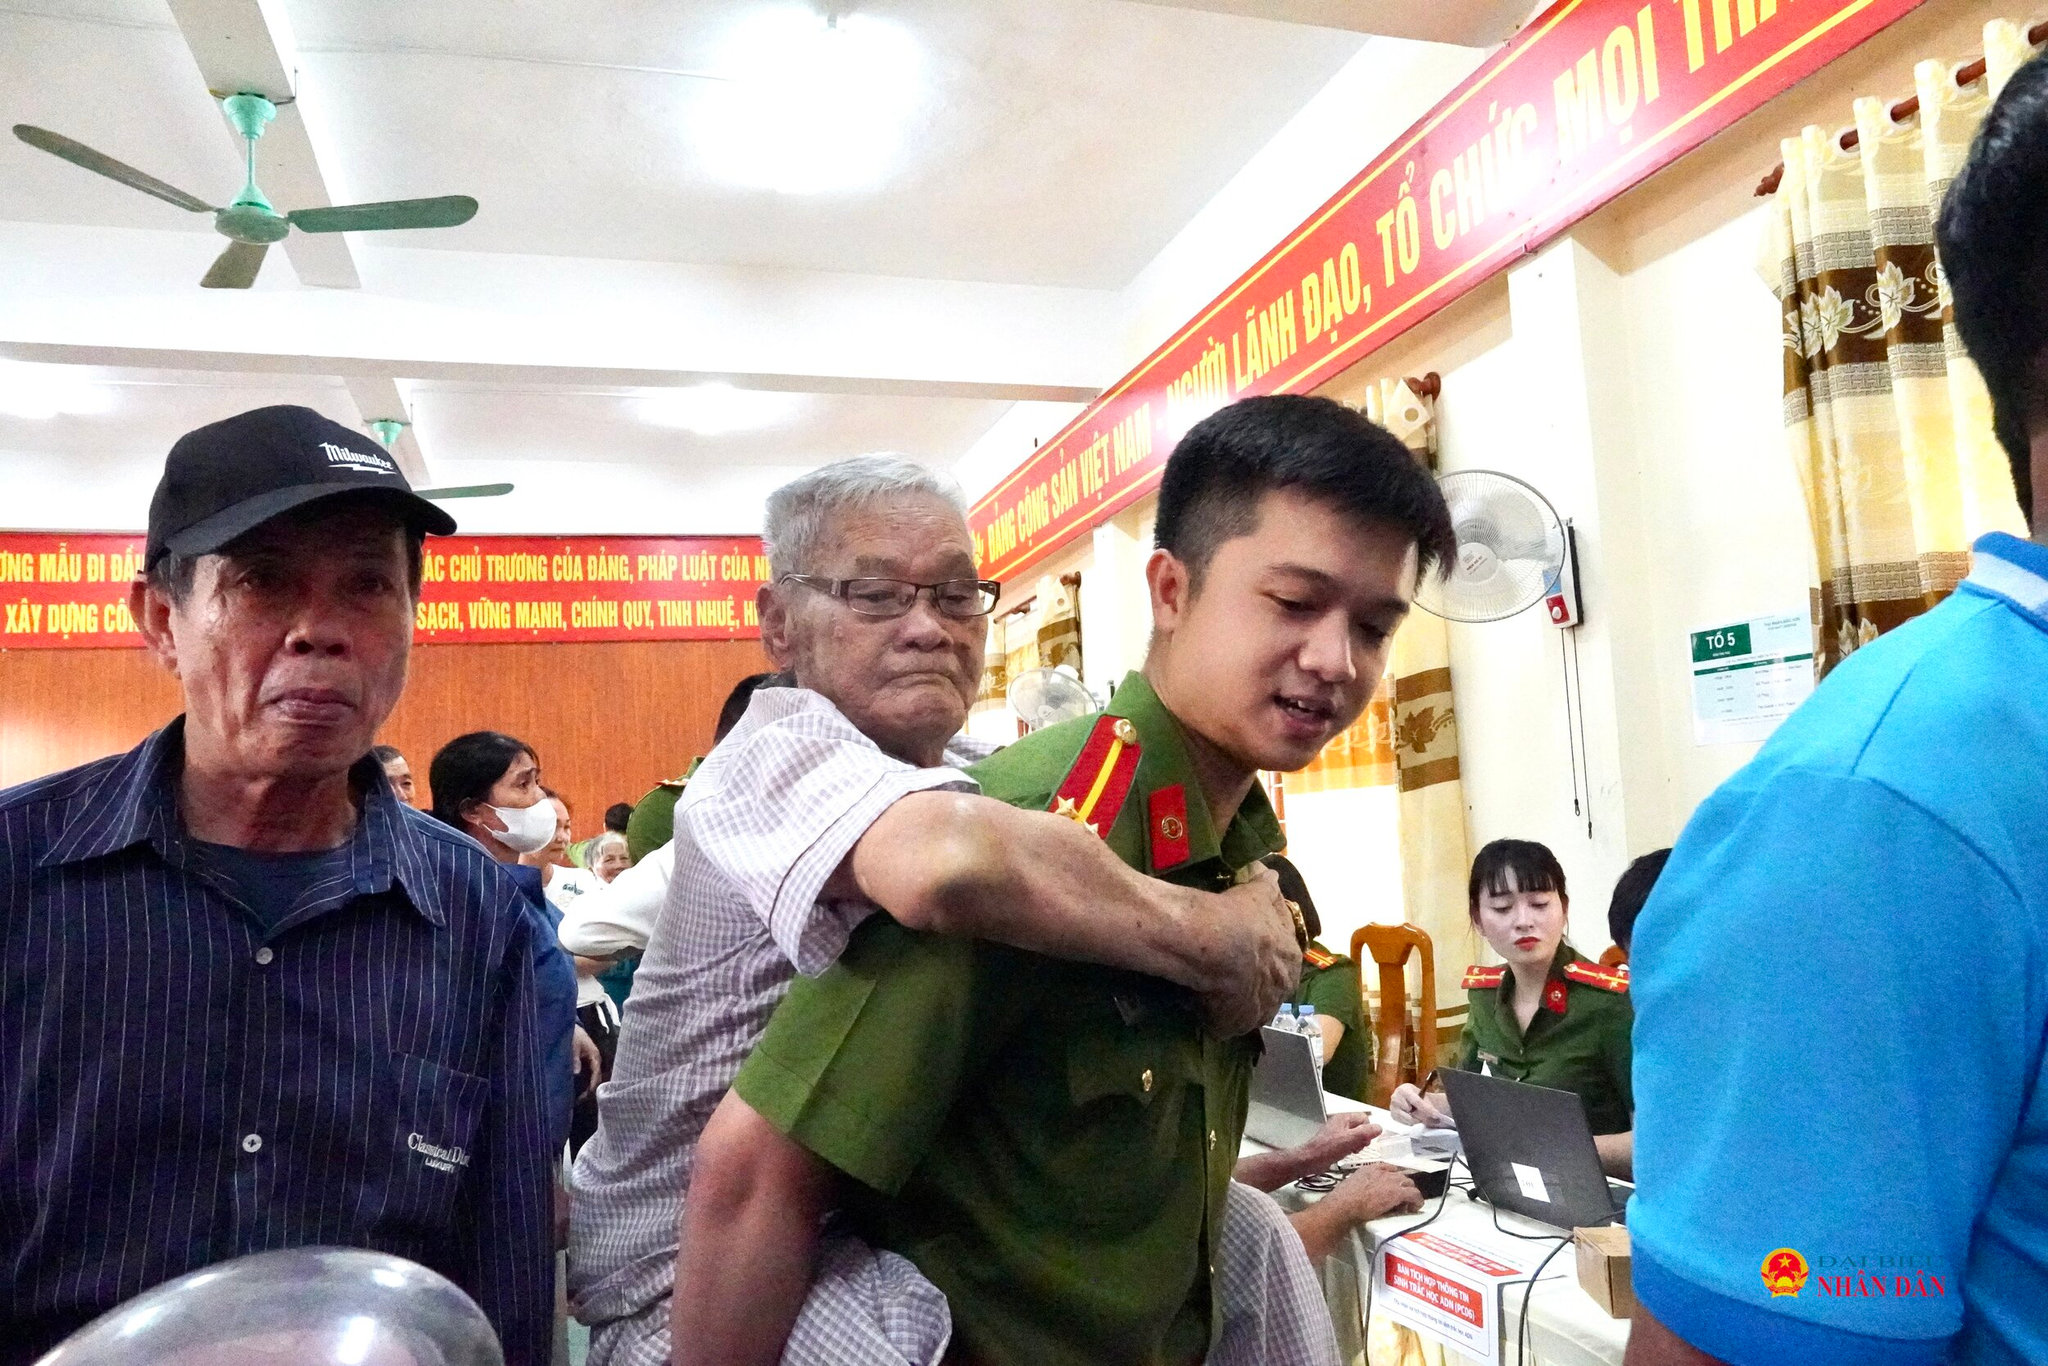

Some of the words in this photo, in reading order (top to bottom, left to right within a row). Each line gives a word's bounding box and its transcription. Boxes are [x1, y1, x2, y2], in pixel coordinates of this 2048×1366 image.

[1017, 482, 1049, 547] CỘNG
[1051, 448, 1078, 519] SẢN
[1080, 430, 1110, 500] VIỆT
[1113, 402, 1152, 476] NAM
[1232, 289, 1297, 393] LÃNH
[1302, 242, 1372, 344] ĐẠO,
[1376, 161, 1421, 288] TỔ
[1430, 100, 1541, 250] CHỨC
[1553, 4, 1660, 168] MỌI
[39, 542, 82, 582] MẪU
[86, 553, 105, 582] ĐI
[423, 549, 445, 582] ÁC
[450, 546, 482, 582] CHỦ
[486, 552, 548, 582] TRƯƠNG
[552, 546, 583, 582] CỦA
[587, 546, 634, 584] ĐẢNG,
[637, 549, 678, 581] PHÁP
[682, 549, 717, 587] LUẬT
[721, 546, 751, 581] CỦA
[5, 597, 42, 633] XÂY
[47, 601, 98, 640] DỰNG
[416, 602, 464, 636] SẠCH,
[468, 596, 511, 629] VỮNG
[515, 602, 567, 635] MẠNH,
[571, 595, 618, 629] CHÍNH
[622, 601, 654, 630] QUY,
[657, 600, 692, 627] TINH
[696, 595, 740, 632] NHUỆ,
[1727, 632, 1736, 646] 5
